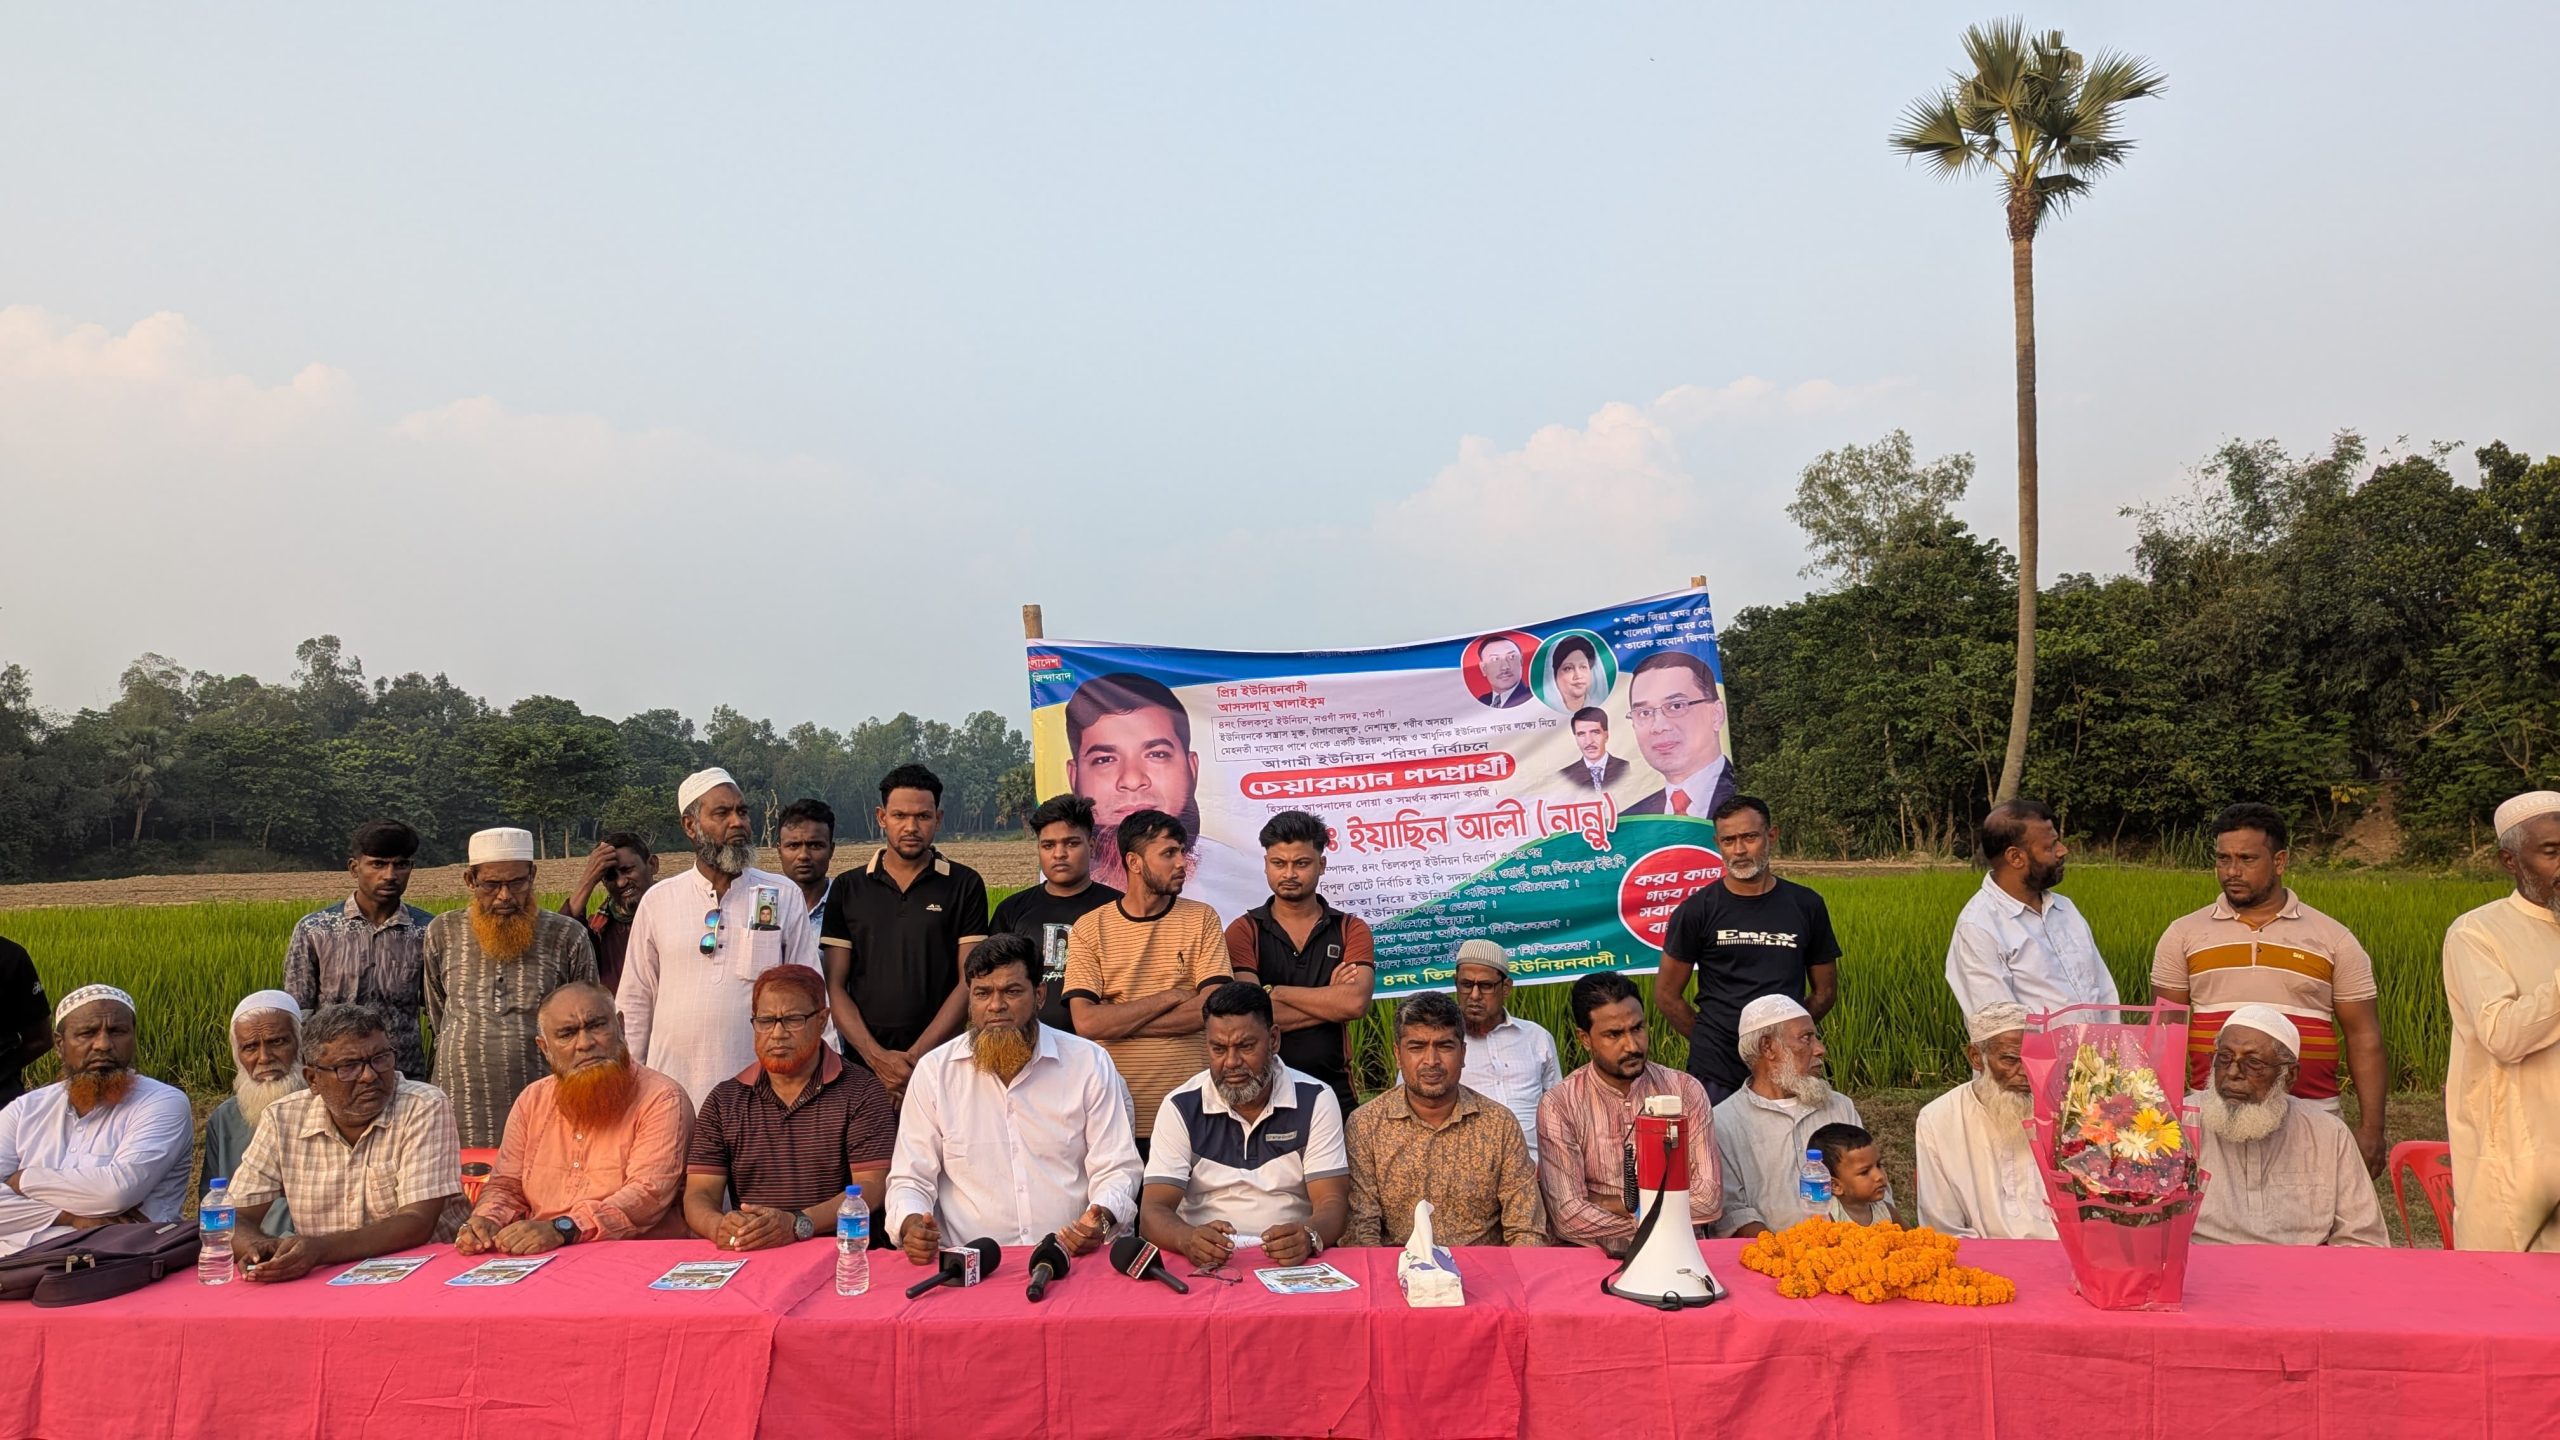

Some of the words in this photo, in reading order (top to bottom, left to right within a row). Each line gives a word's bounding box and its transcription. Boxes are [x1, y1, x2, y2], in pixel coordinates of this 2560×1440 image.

[1648, 611, 1667, 622] জিয়া
[1670, 609, 1690, 618] অমর
[1654, 624, 1673, 633] জিয়া
[1676, 622, 1695, 631] অমর
[1624, 640, 1654, 650] তারেক
[1656, 637, 1683, 647] রহমান
[1217, 687, 1237, 698] প্রিয়
[1241, 681, 1307, 696] ইউনিয়নবাসী
[1274, 697, 1325, 709] আলাইকুম
[1219, 721, 1235, 730] ৪নং
[1237, 718, 1273, 730] তিলকপুর
[1276, 715, 1311, 726] ইউনিয়ন,
[1315, 713, 1336, 723] নওগাঁ
[1339, 712, 1360, 722] সদর,
[1363, 709, 1385, 719] নওগাঁ
[1220, 730, 1264, 742] ইউনিয়নকে
[1291, 729, 1309, 739] মুক্ত,
[1311, 725, 1361, 737] চাঁদাবাজমুক্ত,
[1364, 721, 1400, 733] নেশামুক্ত,
[1403, 718, 1423, 729] গরীব
[1425, 717, 1454, 726] অসহায়
[1255, 745, 1284, 755] মানুষের
[1287, 742, 1307, 752] পাশে
[1309, 741, 1331, 750] থেকে
[1334, 737, 1356, 748] একটি
[1358, 735, 1386, 746] উন্নয়ন,
[1420, 731, 1452, 741] আধুনিক
[1455, 726, 1487, 738] ইউনিয়ন
[1490, 724, 1511, 735] গড়ার
[1539, 718, 1557, 728] নিয়ে
[1262, 755, 1311, 769] আগামী
[1316, 751, 1375, 766] ইউনিয়ন
[1381, 747, 1427, 761] পরিষদ
[1433, 741, 1489, 756] নির্বাচনে
[1249, 771, 1394, 796] চেয়ারম্যান
[1302, 801, 1352, 812] আপনাদের
[1356, 798, 1381, 808] দোয়া
[1396, 794, 1426, 805] সমর্থন
[1430, 791, 1460, 802] কামনা
[1464, 787, 1492, 799] করছি
[1347, 808, 1448, 853] ইয়াছিন
[1454, 798, 1528, 841] আলী
[1537, 792, 1616, 849] (নান্নু)
[1362, 863, 1380, 873] ৪নং
[1381, 859, 1421, 871] তিলকপুর
[1424, 855, 1460, 868] ইউনিয়ন
[1463, 850, 1497, 864] বিএনপি
[1320, 882, 1345, 895] বিপুল
[1348, 879, 1374, 892] ভোটে
[1377, 876, 1412, 890] নির্বাচিত
[1635, 872, 1678, 887] করব
[1684, 867, 1723, 882] কাজ
[1335, 896, 1371, 909] সততা
[1376, 894, 1404, 905] নিয়ে
[1409, 890, 1460, 903] ইউনিয়ন
[1464, 885, 1506, 898] পরিষদ
[1509, 879, 1570, 894] পরিচালনা
[1646, 888, 1683, 903] গড়ব
[1362, 907, 1414, 920] ইউনিয়ন
[1384, 974, 1419, 986] ৪নং
[1508, 951, 1616, 975] ইউনিয়নবাসী
